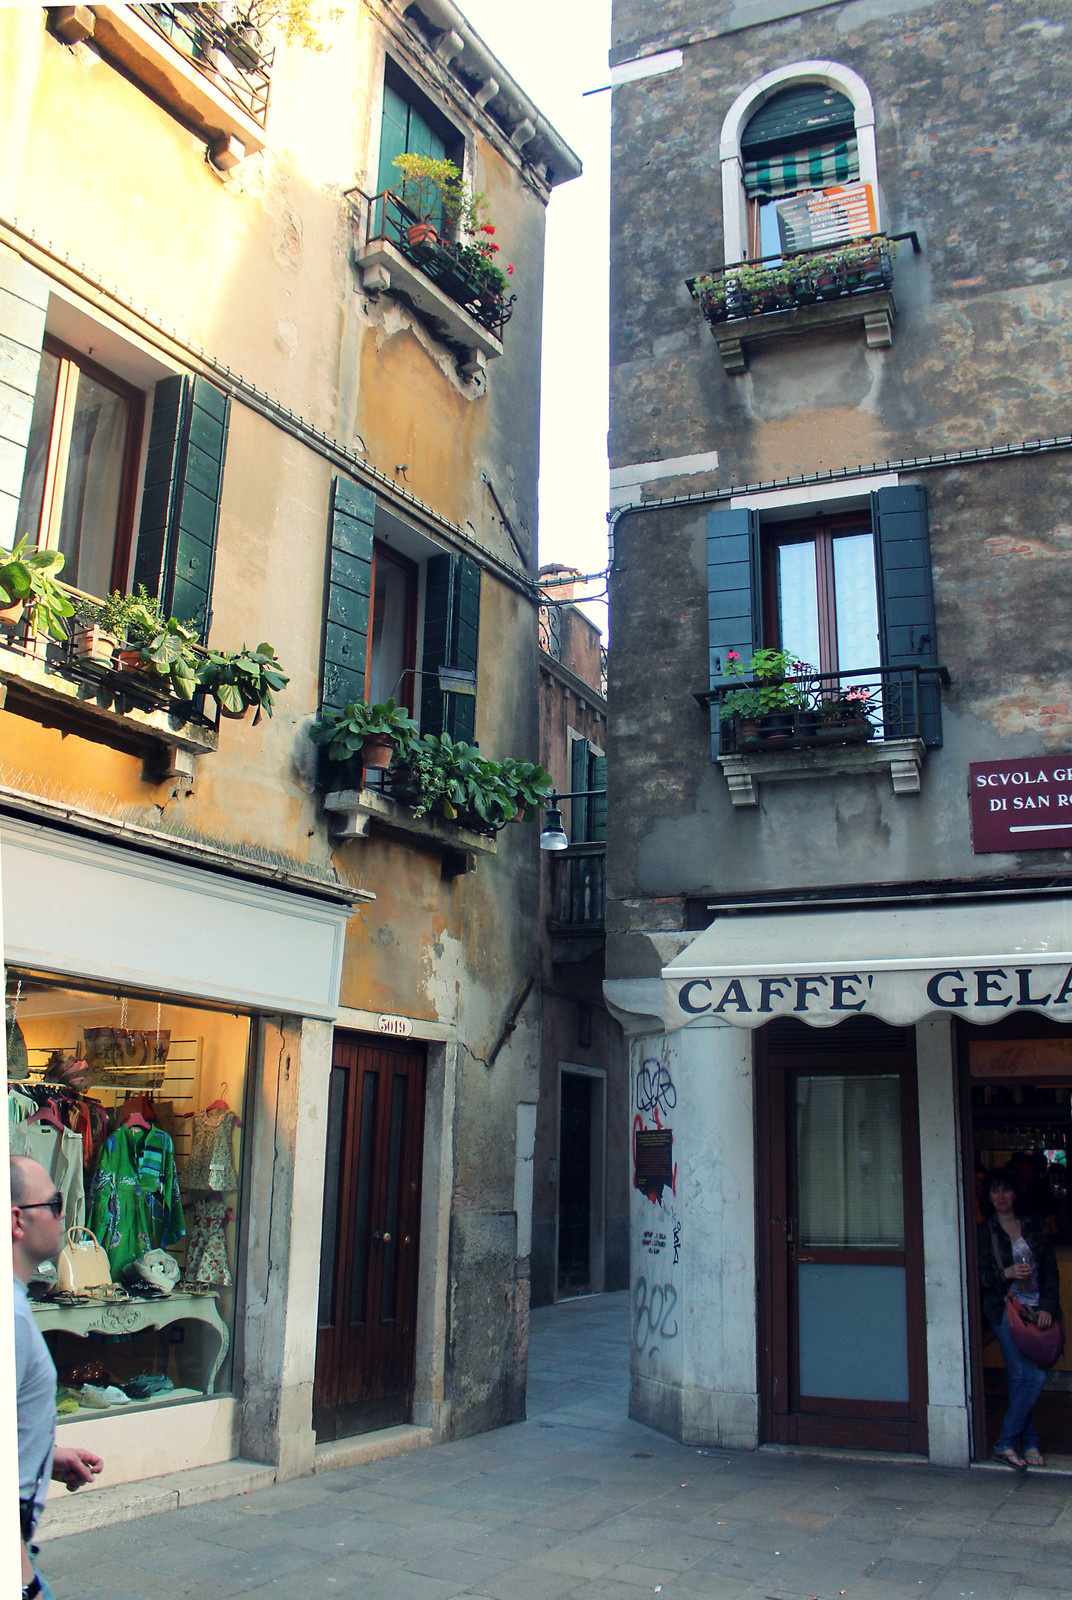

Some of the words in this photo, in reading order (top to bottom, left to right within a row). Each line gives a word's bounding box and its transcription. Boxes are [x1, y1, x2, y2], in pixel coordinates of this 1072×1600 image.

[976, 770, 1049, 787] SCVOLA
[989, 798, 1008, 812] DI
[1013, 795, 1050, 810] SAN
[381, 1018, 406, 1034] 5019
